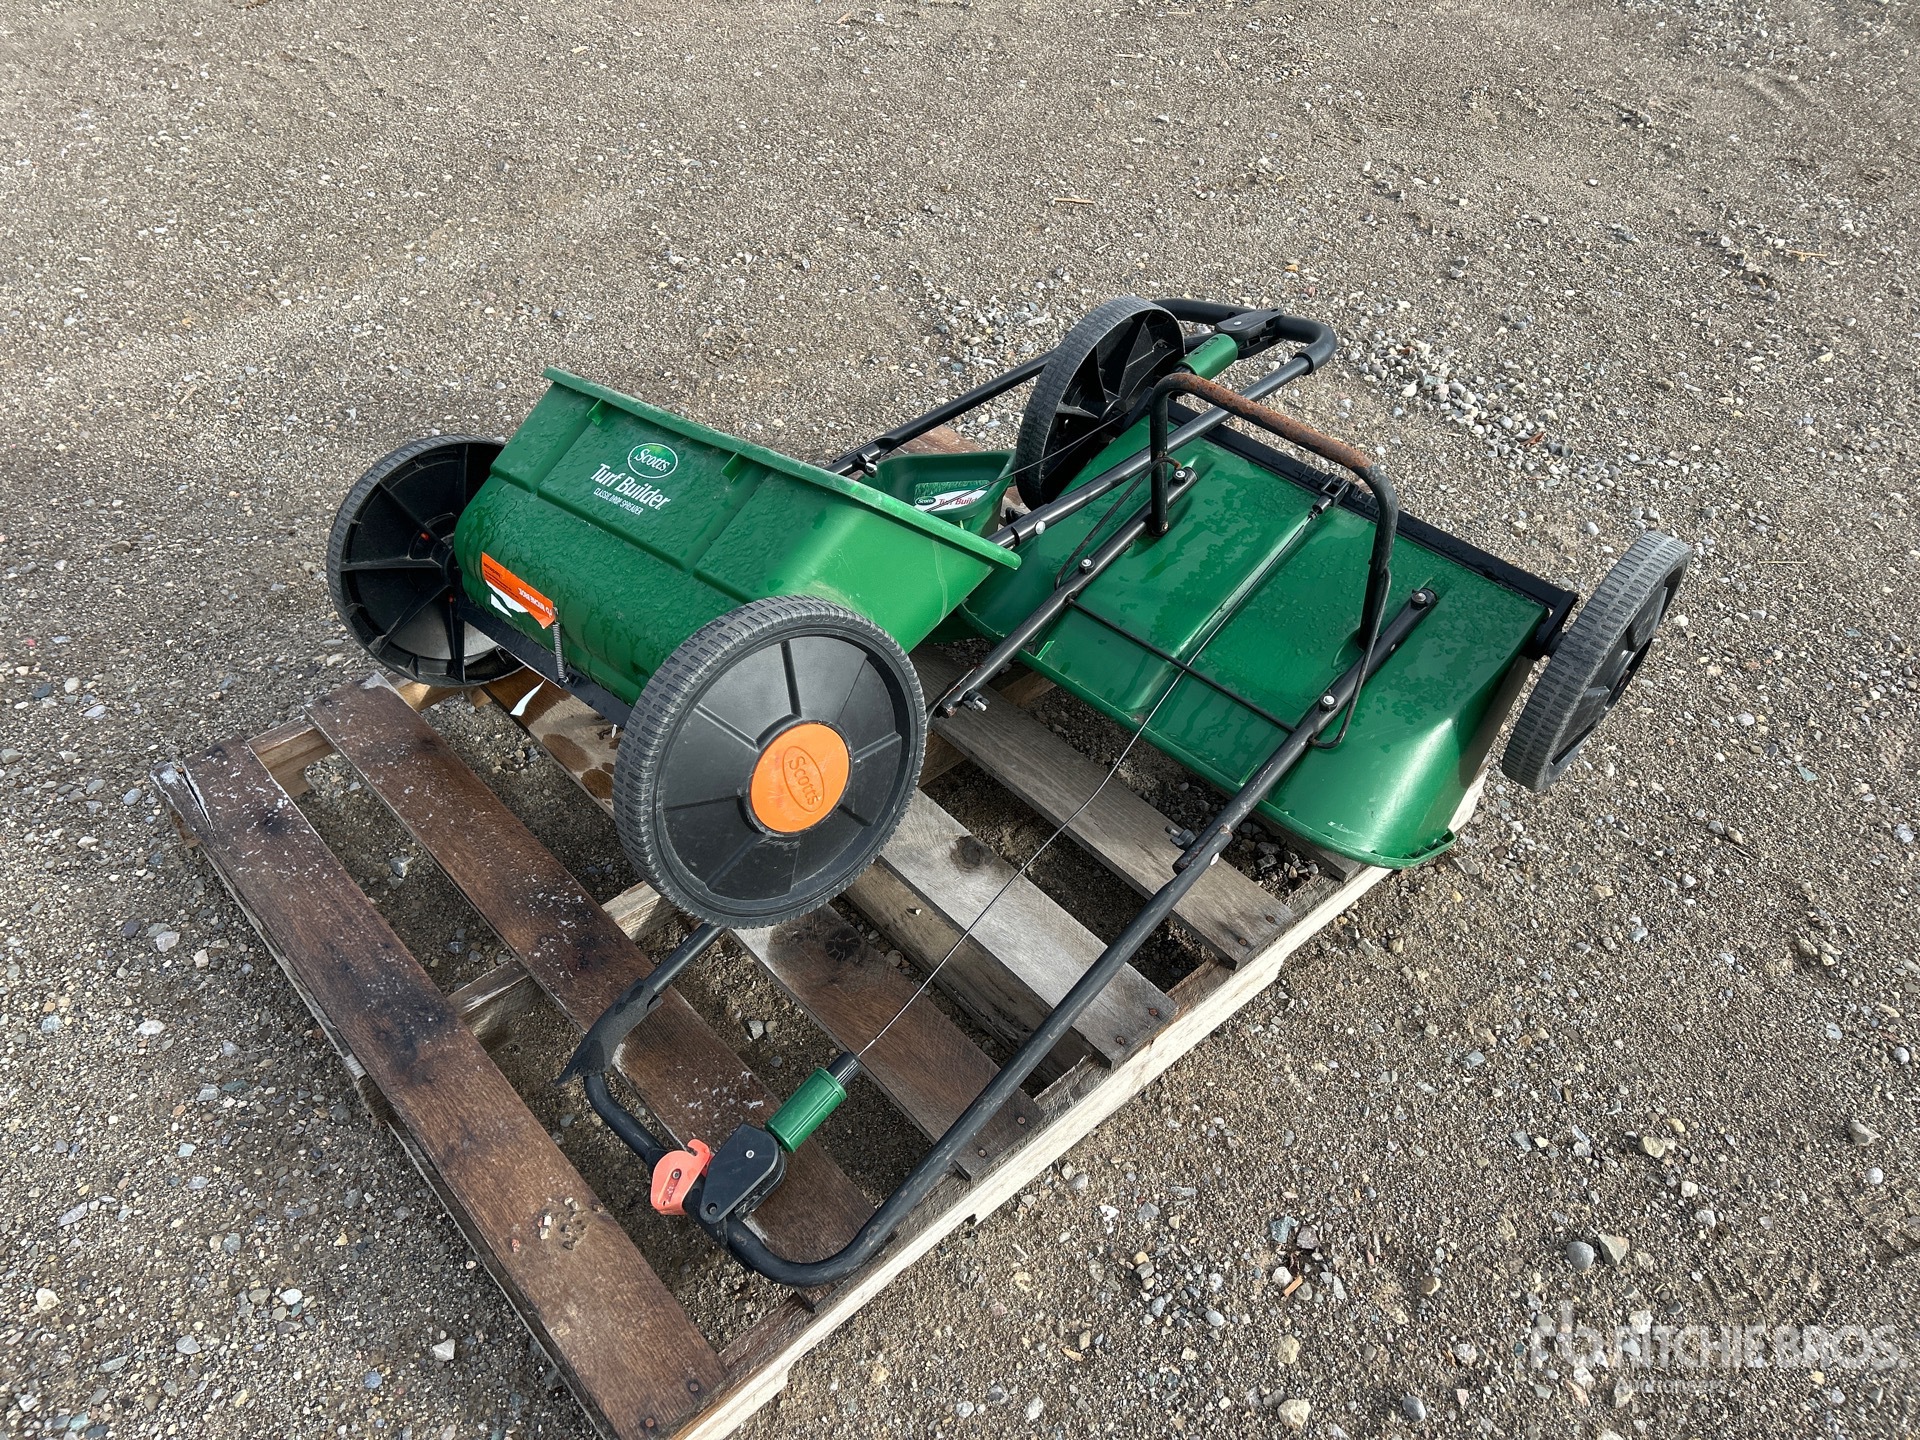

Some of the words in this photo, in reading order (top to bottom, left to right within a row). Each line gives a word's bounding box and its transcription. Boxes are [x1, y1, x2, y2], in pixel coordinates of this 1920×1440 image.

[634, 448, 670, 472] Scotts
[590, 463, 626, 487] Turf
[614, 476, 671, 510] Builder
[620, 499, 644, 516] SPREADER
[788, 756, 820, 805] Scotts
